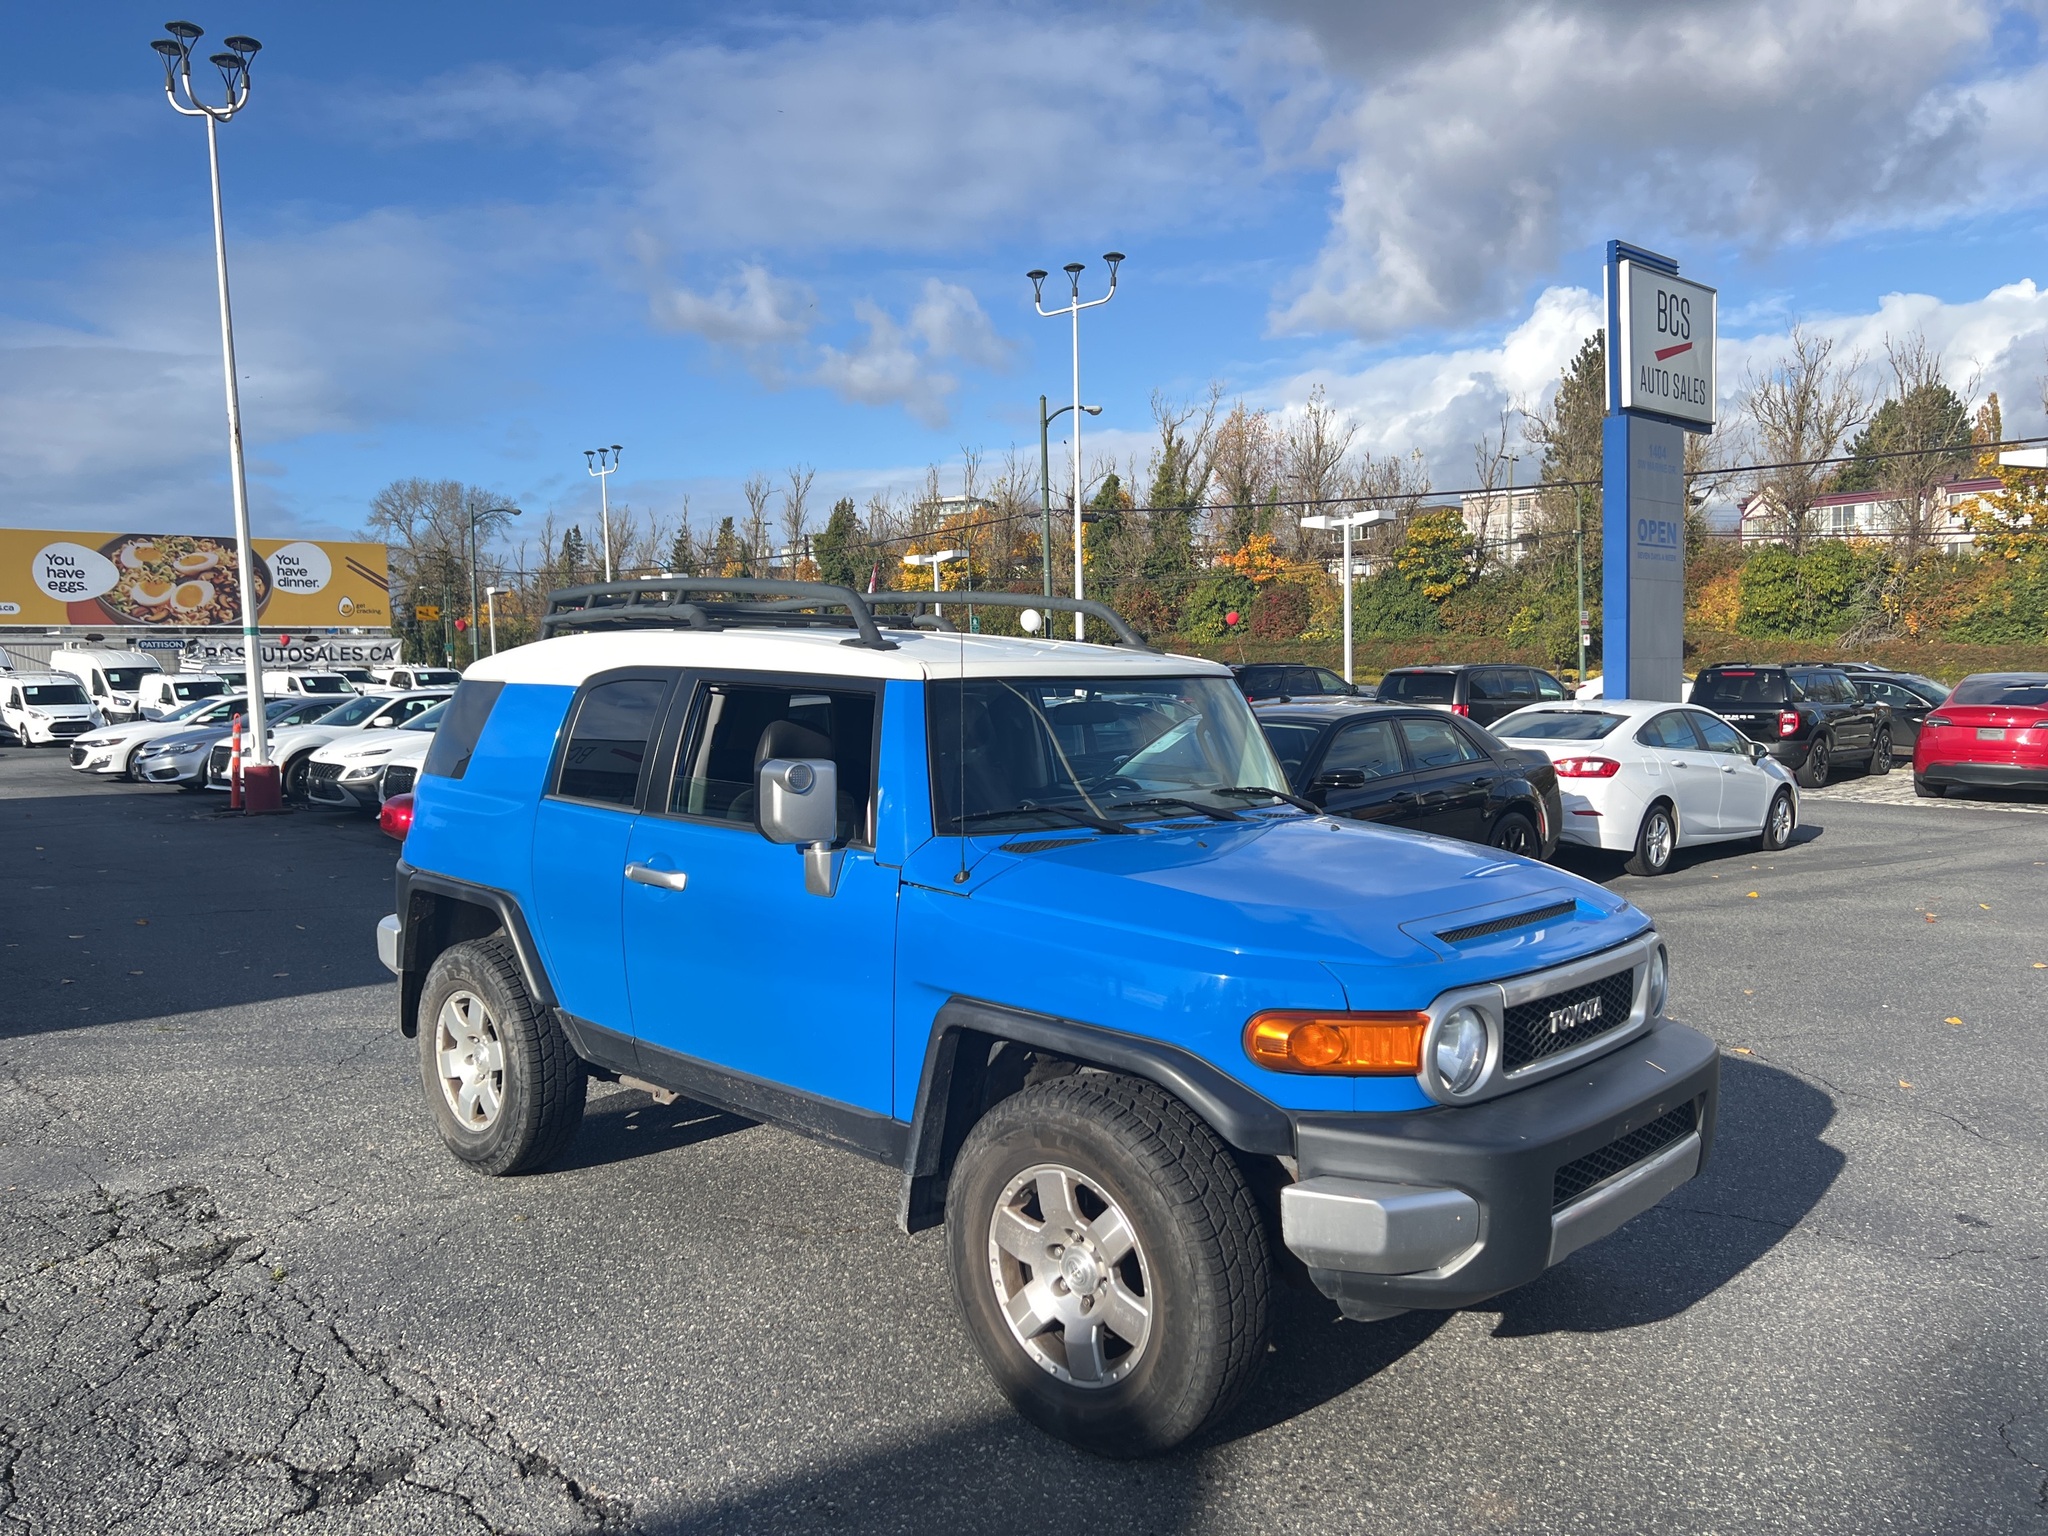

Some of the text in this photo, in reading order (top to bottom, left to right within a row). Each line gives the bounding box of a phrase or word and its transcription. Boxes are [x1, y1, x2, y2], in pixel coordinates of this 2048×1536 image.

[1657, 289, 1691, 340] BCS
[1640, 365, 1706, 406] AUTO SALES
[1649, 444, 1667, 460] 1404
[1637, 518, 1677, 545] OPEN
[45, 553, 75, 566] You
[276, 554, 300, 566] You
[46, 566, 86, 579] have
[277, 565, 308, 577] have
[48, 580, 88, 593] eggs.
[278, 577, 320, 588] dinner.
[140, 641, 184, 649] PATTISON
[1549, 995, 1603, 1034] TOYOTA
